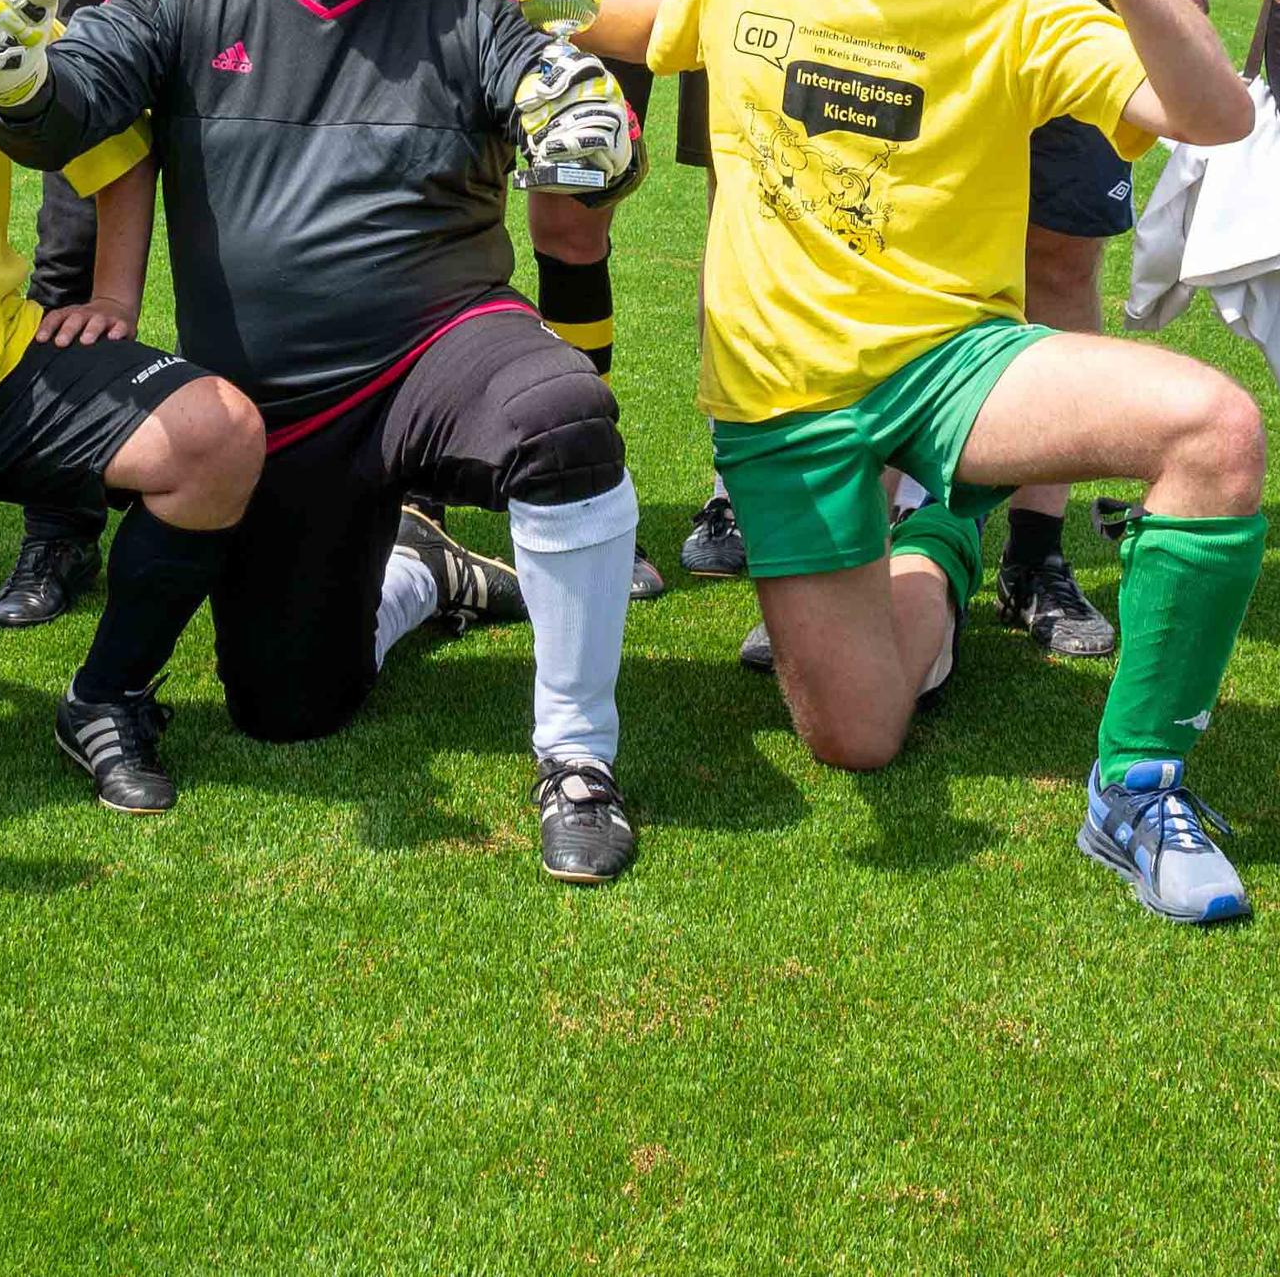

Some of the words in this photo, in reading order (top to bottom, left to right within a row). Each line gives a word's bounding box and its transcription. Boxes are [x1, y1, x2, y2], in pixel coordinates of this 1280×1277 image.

[744, 26, 778, 50] CID
[797, 24, 895, 54] Christlich-Islamischer
[896, 44, 927, 61] Dialog
[813, 43, 826, 55] im
[827, 46, 851, 61] Kreis
[795, 67, 913, 108] Interreligiöses
[823, 101, 877, 129] Kicken
